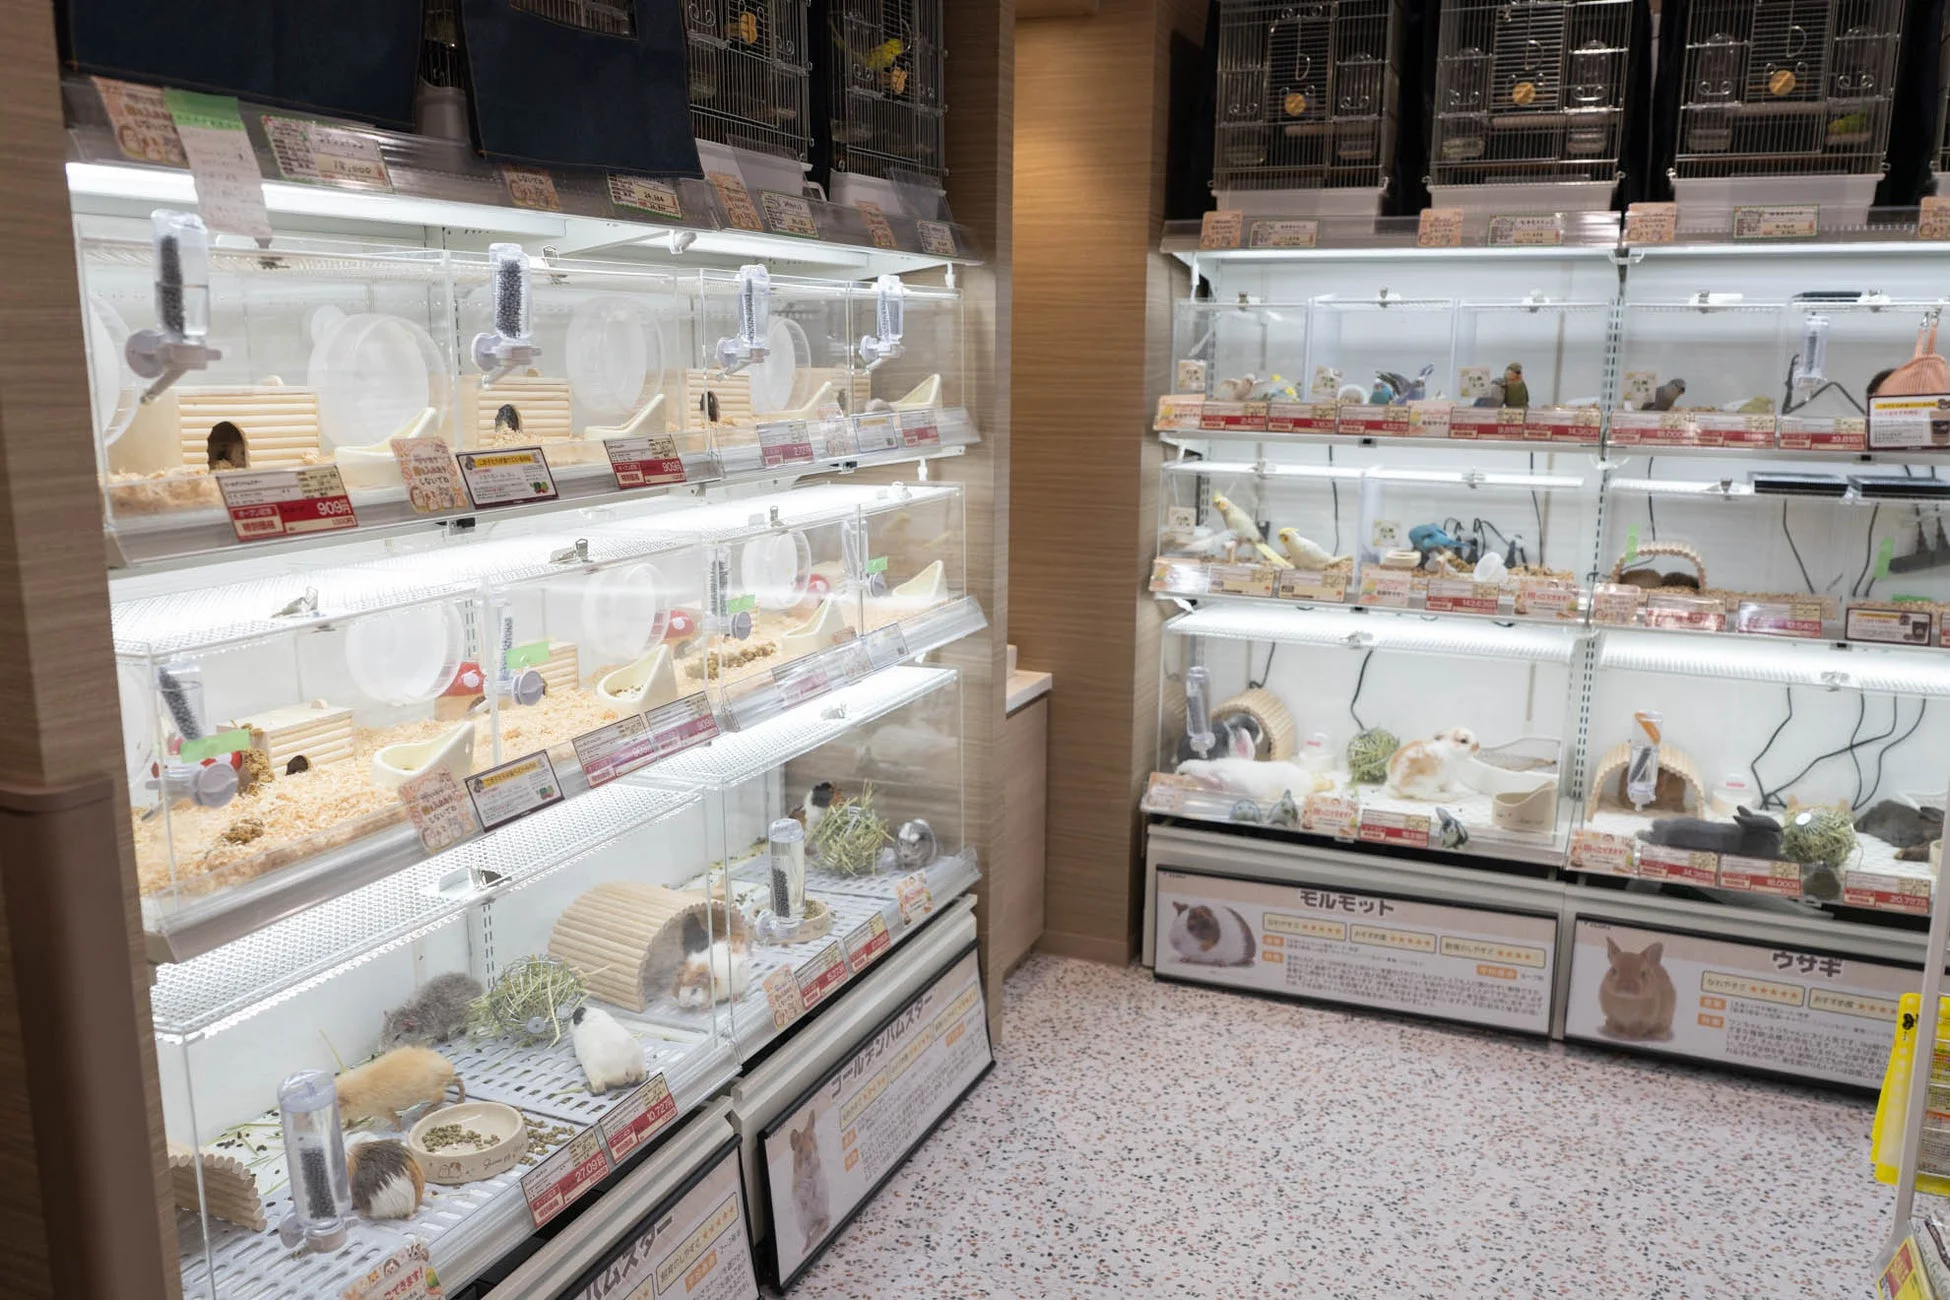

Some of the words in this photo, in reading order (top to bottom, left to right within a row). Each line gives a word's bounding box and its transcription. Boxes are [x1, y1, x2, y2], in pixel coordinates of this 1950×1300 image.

[1300, 890, 1395, 916] モルモット
[1773, 951, 1841, 977] ウサギ
